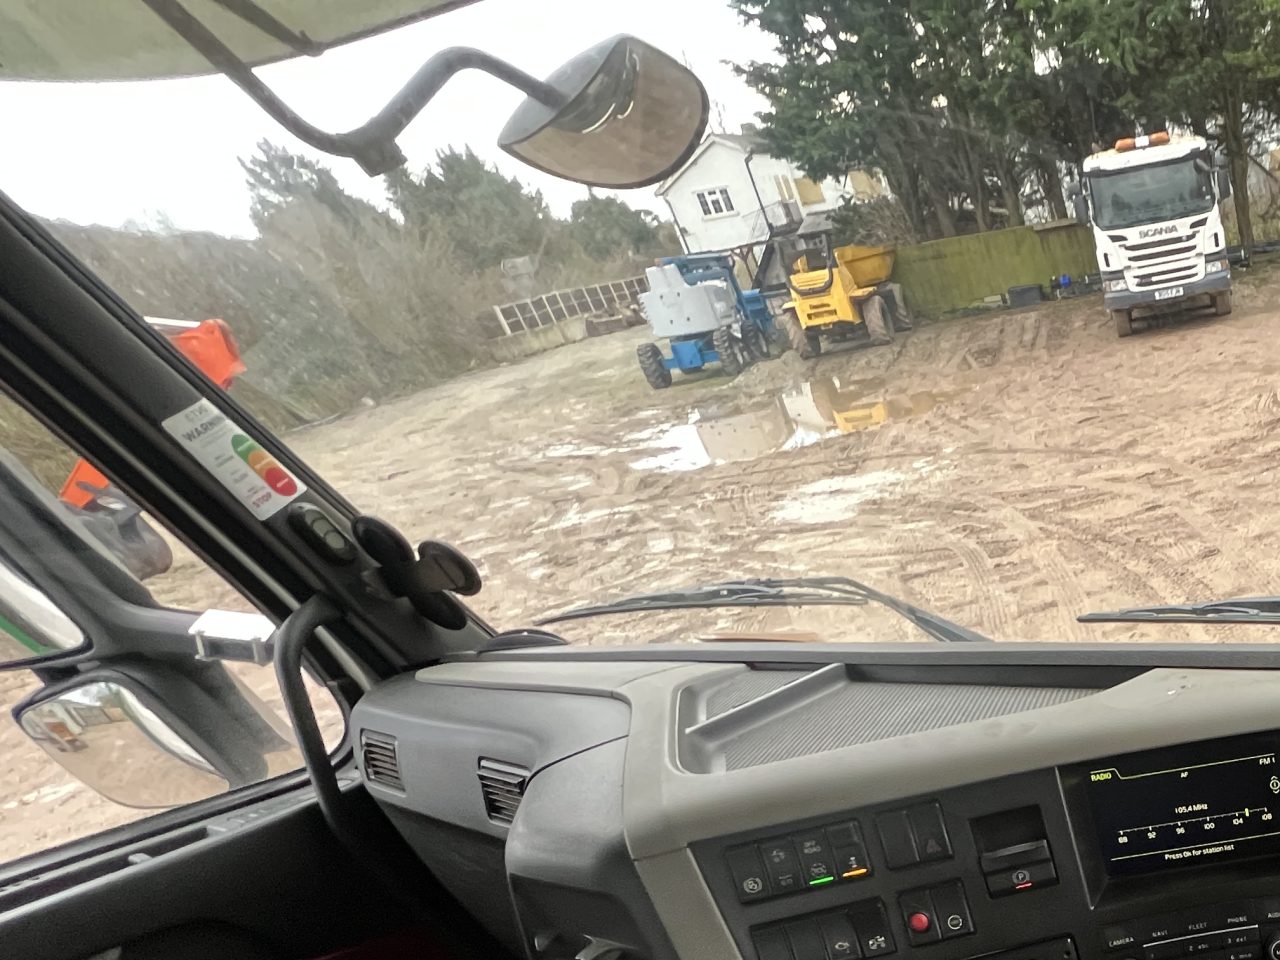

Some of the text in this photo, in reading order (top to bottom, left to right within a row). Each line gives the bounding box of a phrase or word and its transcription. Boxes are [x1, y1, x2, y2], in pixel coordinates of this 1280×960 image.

[1138, 224, 1179, 239] SCANIA
[181, 415, 227, 442] WARN
[1258, 757, 1271, 765] FM
[1090, 772, 1111, 782] RADIO
[1174, 803, 1209, 814] 105.4 MHz
[1232, 817, 1244, 825] 104
[1203, 822, 1215, 830] 100
[1147, 831, 1157, 839] 92
[1175, 827, 1186, 835] 96
[1164, 852, 1183, 861] Press
[1192, 849, 1202, 857] for
[1202, 845, 1224, 855] station
[1223, 843, 1235, 851] list
[1227, 915, 1247, 924] PHONE
[1188, 922, 1207, 931] FLEET
[1151, 930, 1168, 938] NAVI
[1108, 936, 1134, 948] CAMERA
